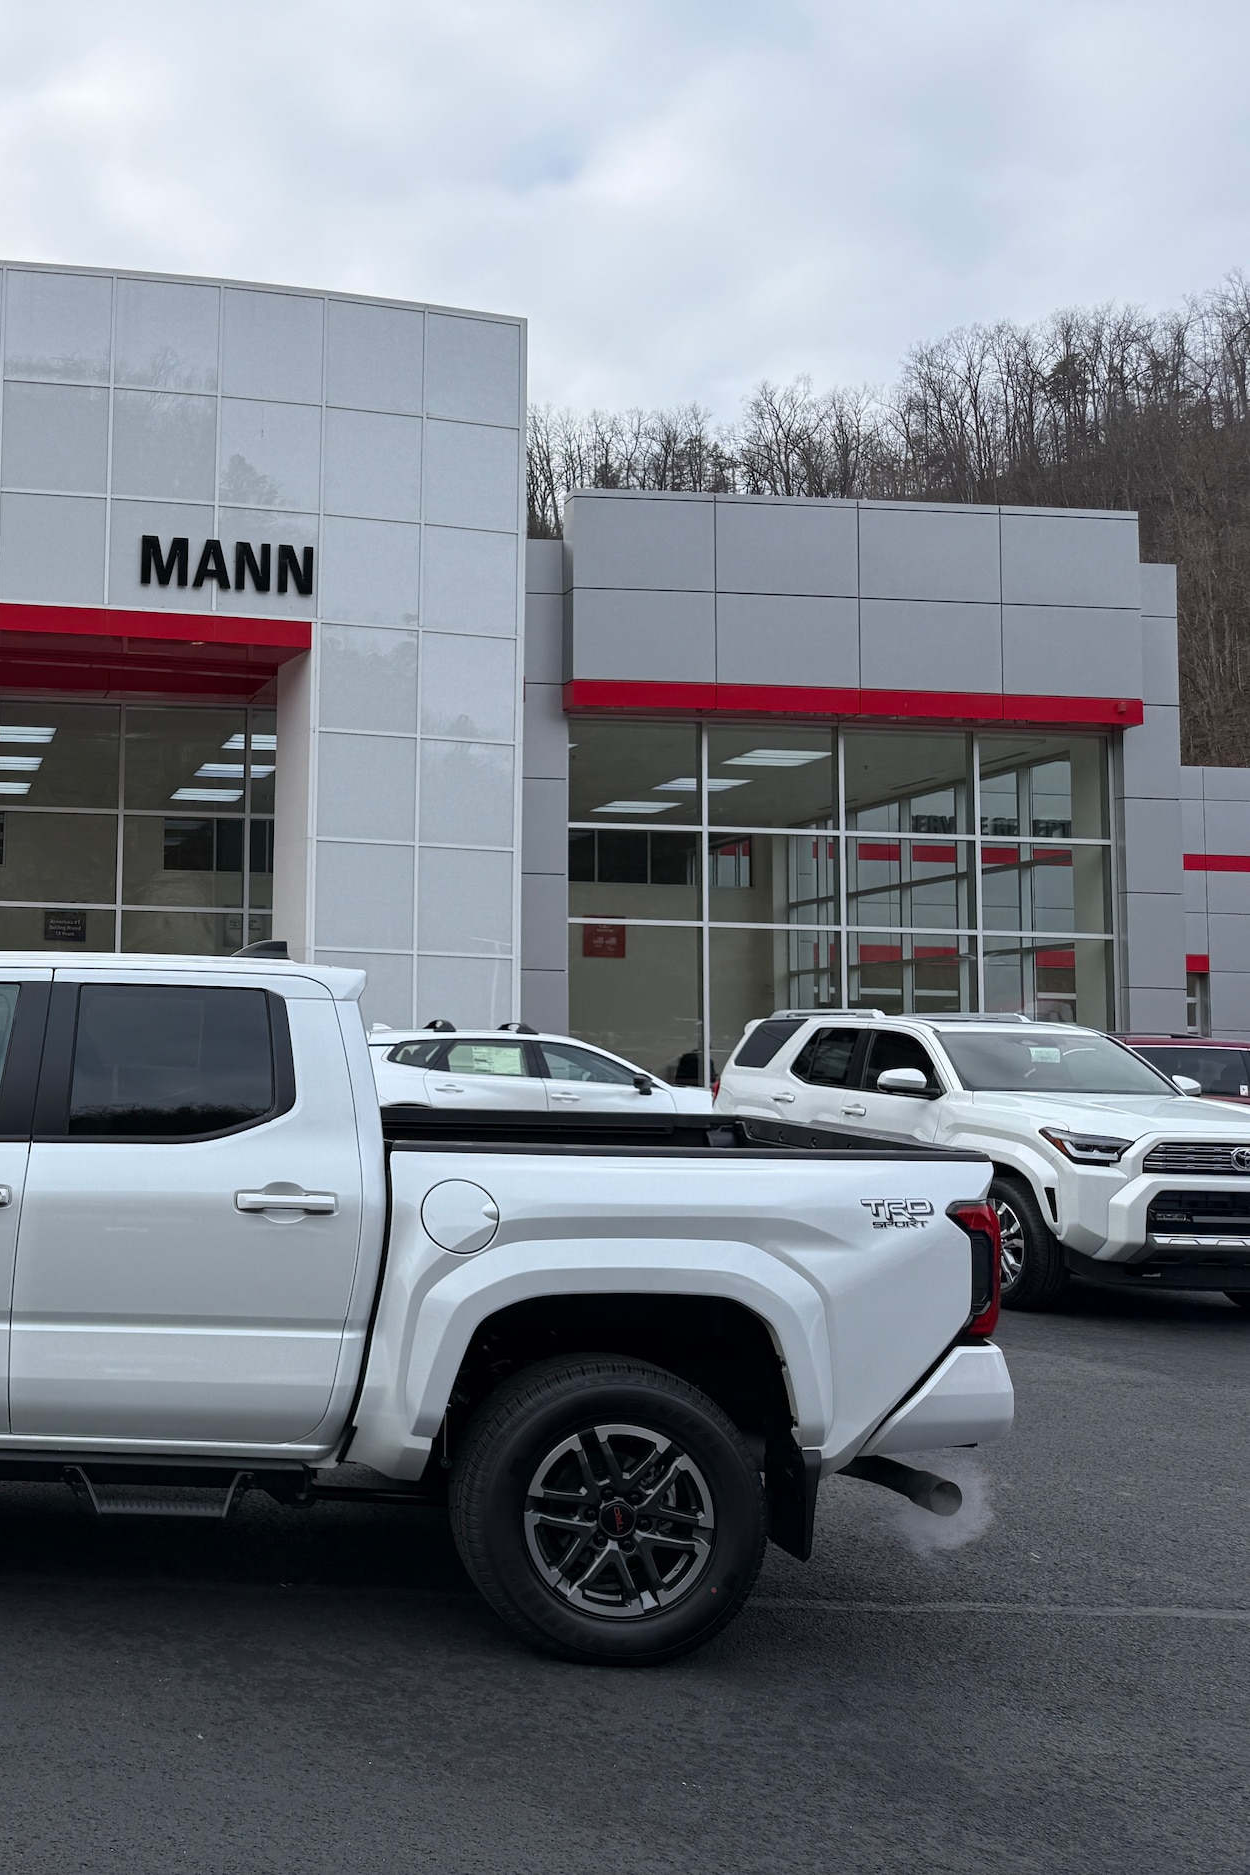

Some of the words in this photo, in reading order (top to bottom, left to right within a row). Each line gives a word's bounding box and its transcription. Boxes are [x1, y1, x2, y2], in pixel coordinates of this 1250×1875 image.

[141, 535, 314, 595] MANN
[860, 1198, 935, 1222] TRD
[872, 1220, 929, 1229] SPORT
